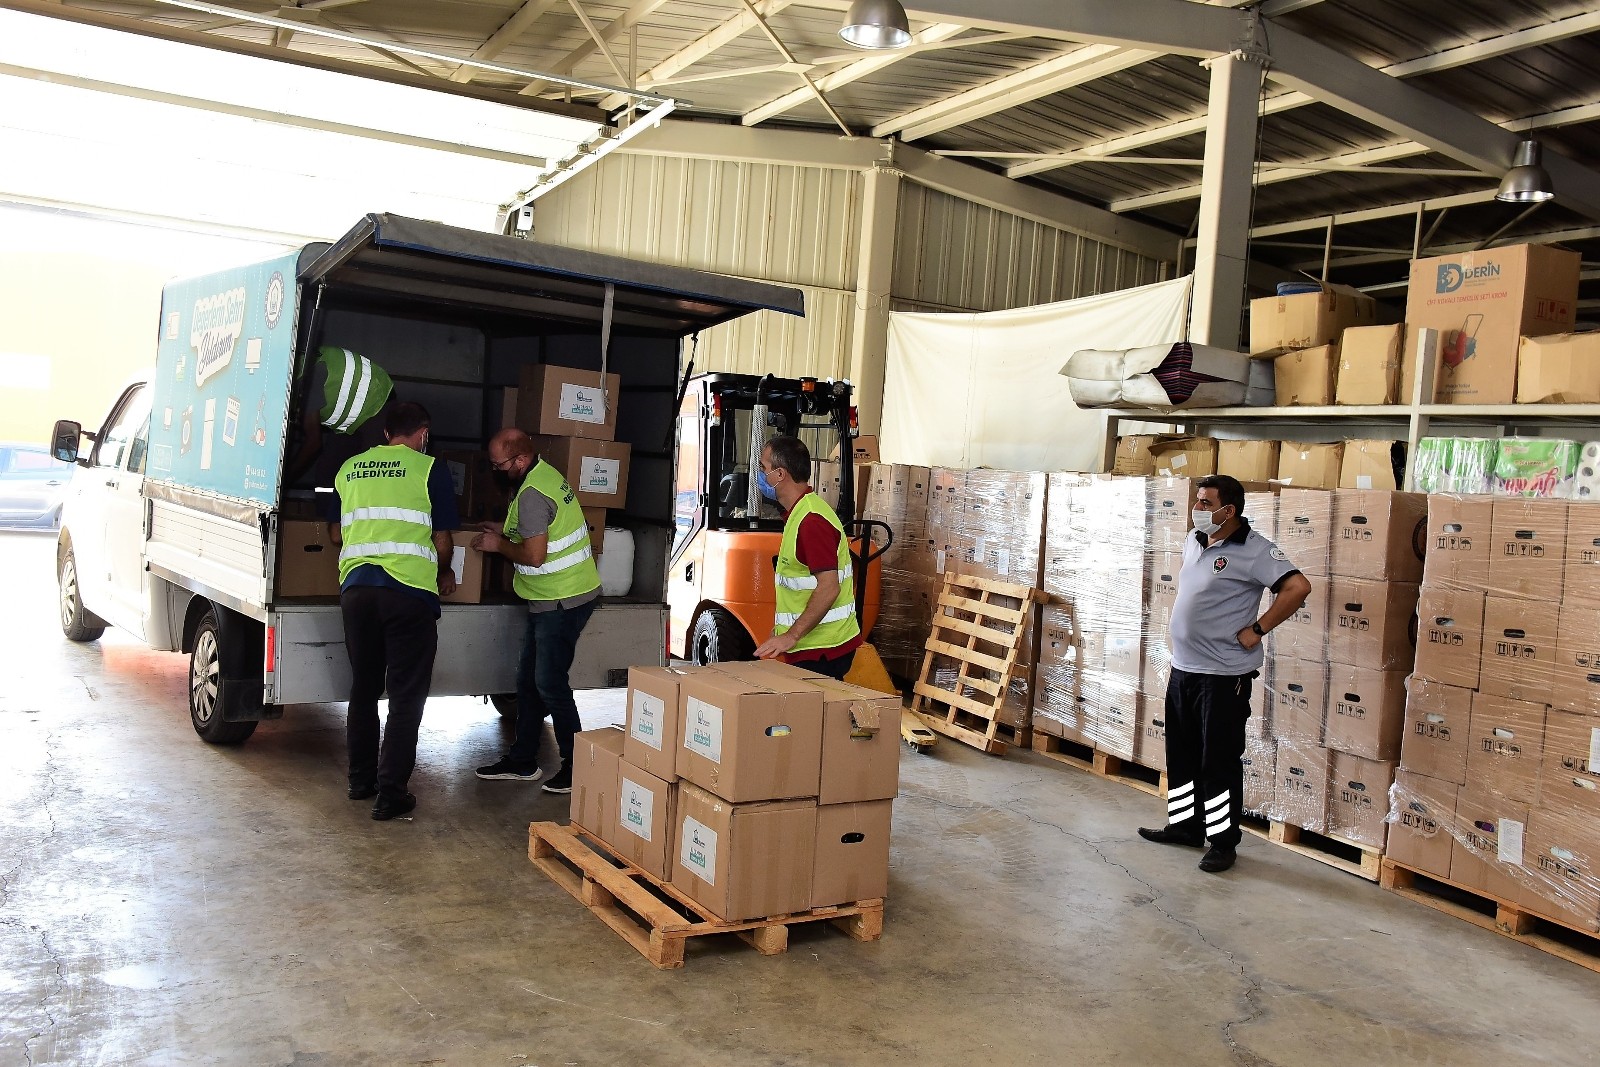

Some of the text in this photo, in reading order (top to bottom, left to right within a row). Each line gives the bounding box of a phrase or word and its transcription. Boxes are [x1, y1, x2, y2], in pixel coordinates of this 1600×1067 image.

[1464, 261, 1500, 279] DERİN
[353, 460, 401, 470] YILDIRIM
[346, 467, 407, 483] BELEDİYESİ
